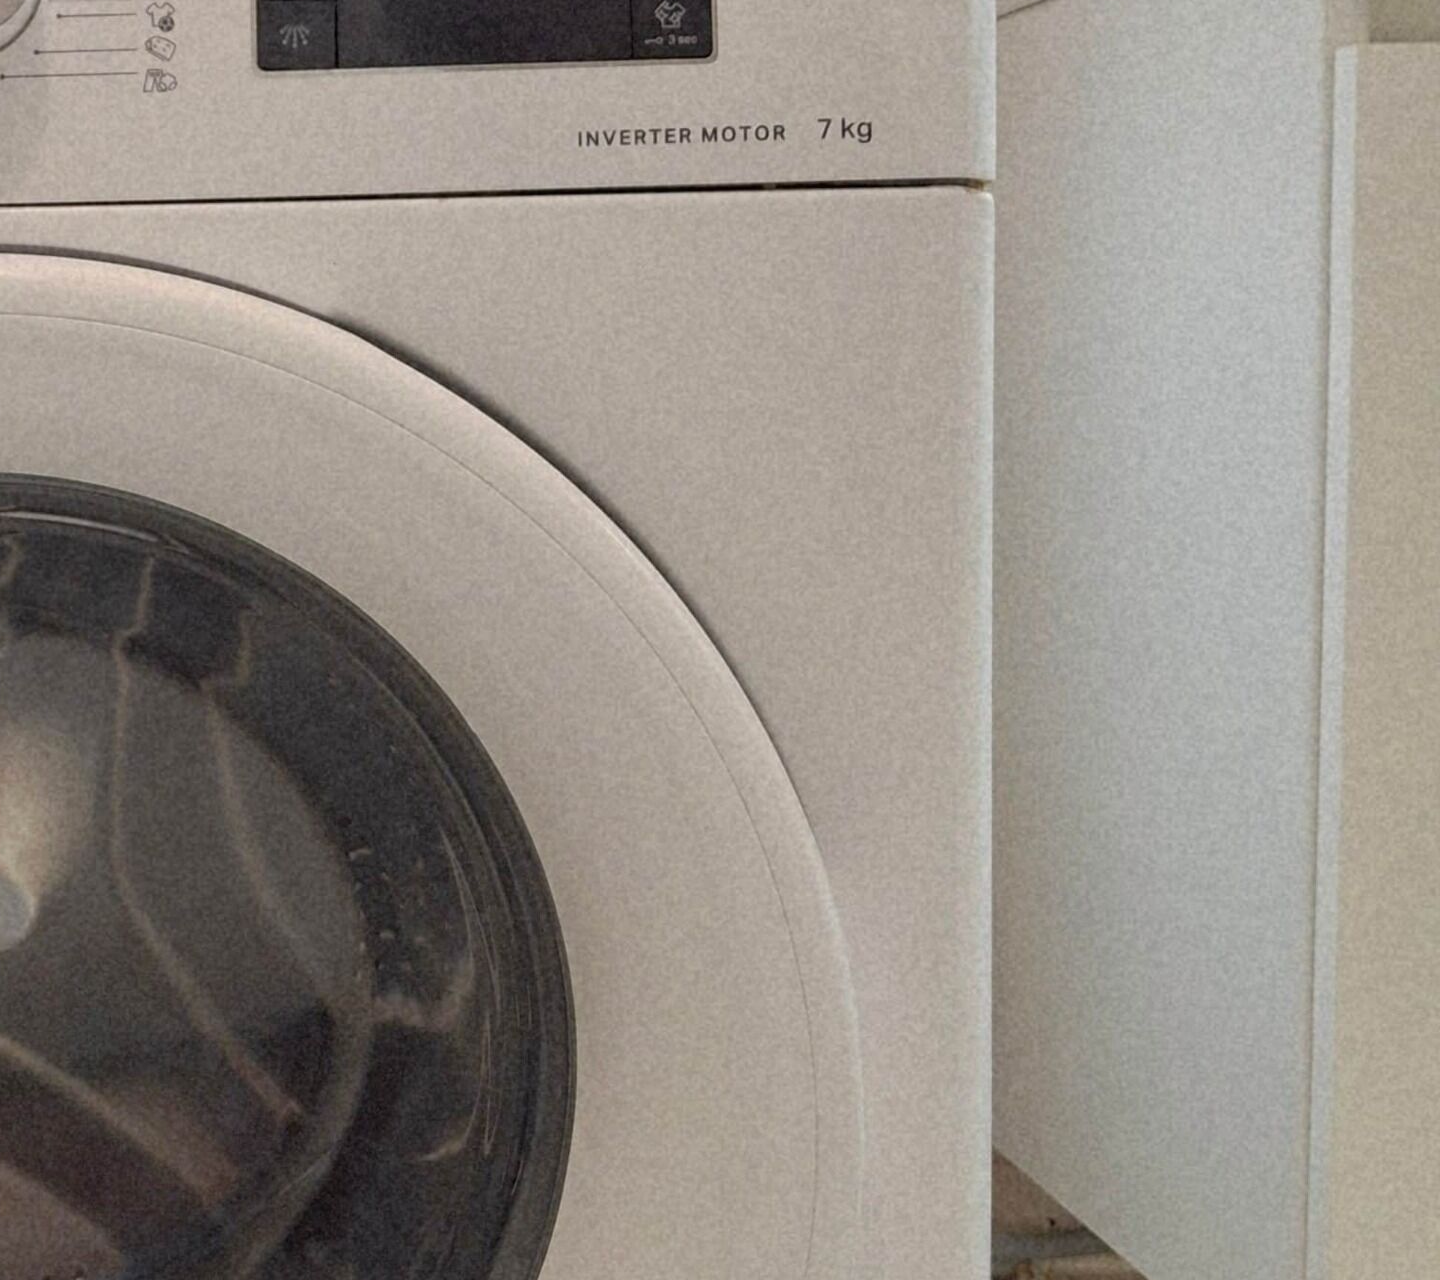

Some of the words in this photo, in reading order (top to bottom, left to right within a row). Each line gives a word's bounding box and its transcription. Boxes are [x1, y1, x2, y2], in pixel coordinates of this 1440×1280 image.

[668, 34, 676, 45] 3
[578, 128, 692, 147] INVERTER
[702, 124, 787, 143] MOTOR
[818, 118, 833, 140] 7
[841, 117, 873, 143] kg
